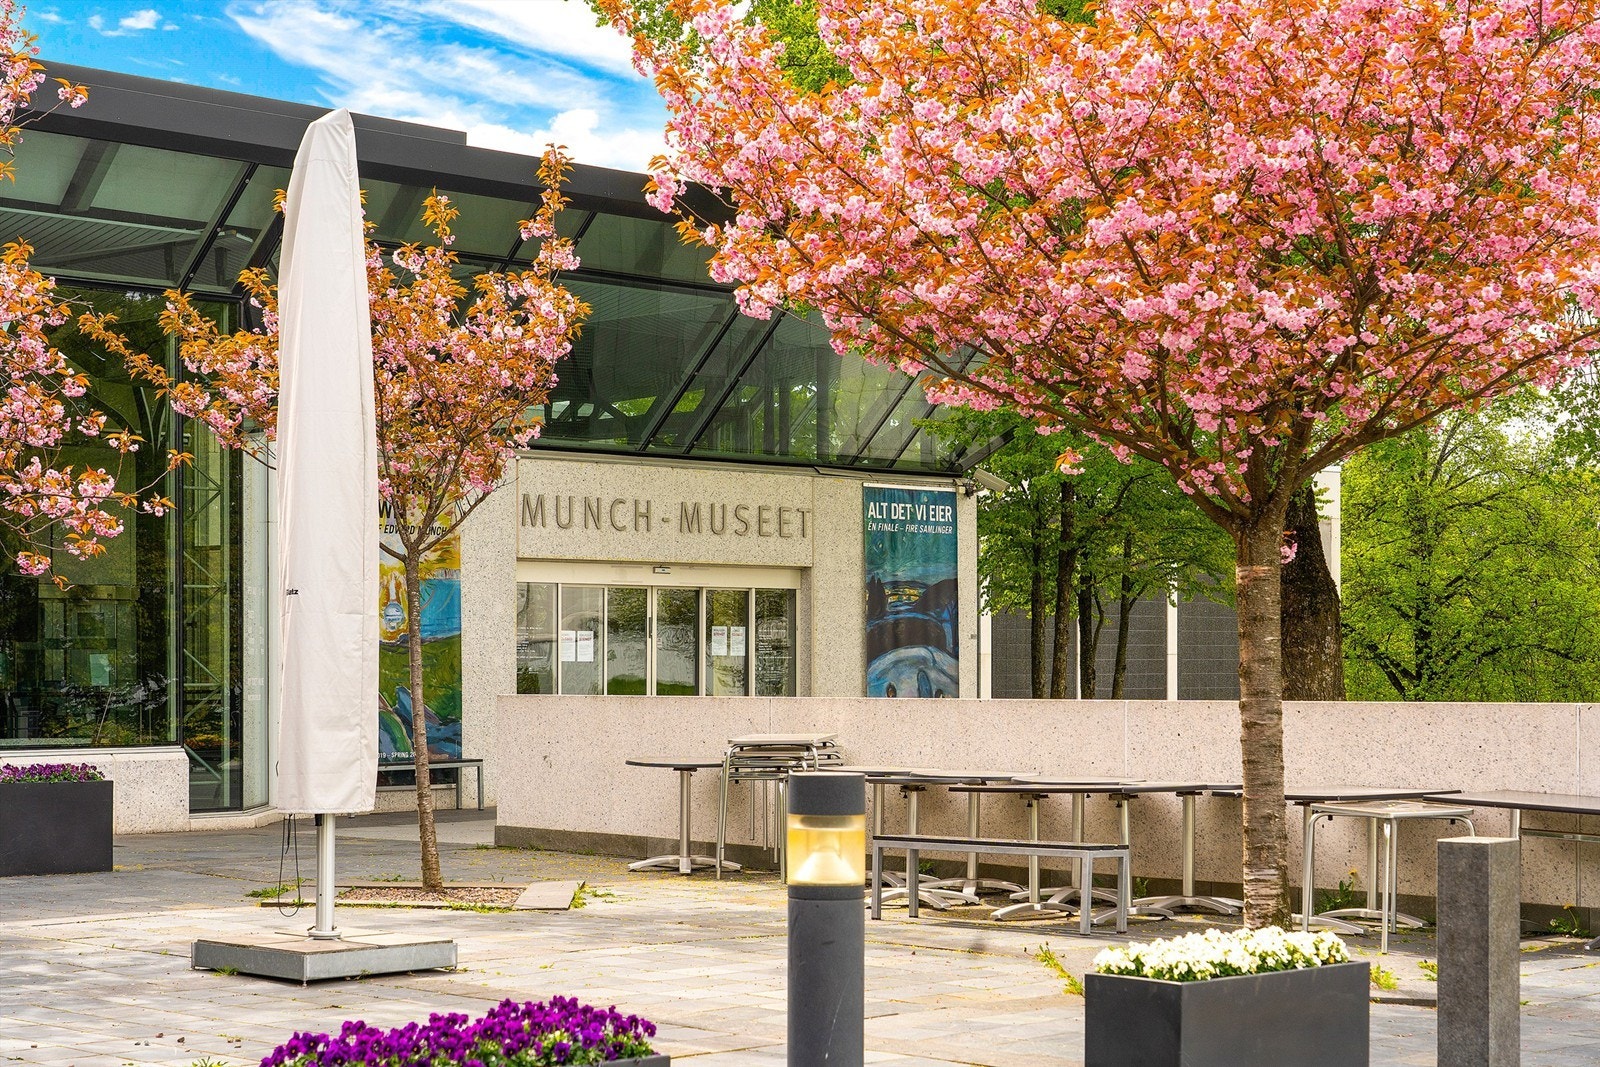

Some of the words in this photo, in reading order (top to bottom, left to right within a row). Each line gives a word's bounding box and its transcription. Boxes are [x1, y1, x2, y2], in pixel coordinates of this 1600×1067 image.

[868, 502, 888, 519] ALT
[891, 503, 912, 520] DET
[915, 504, 927, 521] VI
[929, 505, 952, 522] EIER
[868, 521, 877, 531] ÉN
[878, 523, 899, 532] FINALE
[905, 524, 918, 533] FIRE
[919, 524, 953, 534] SAMLINGER
